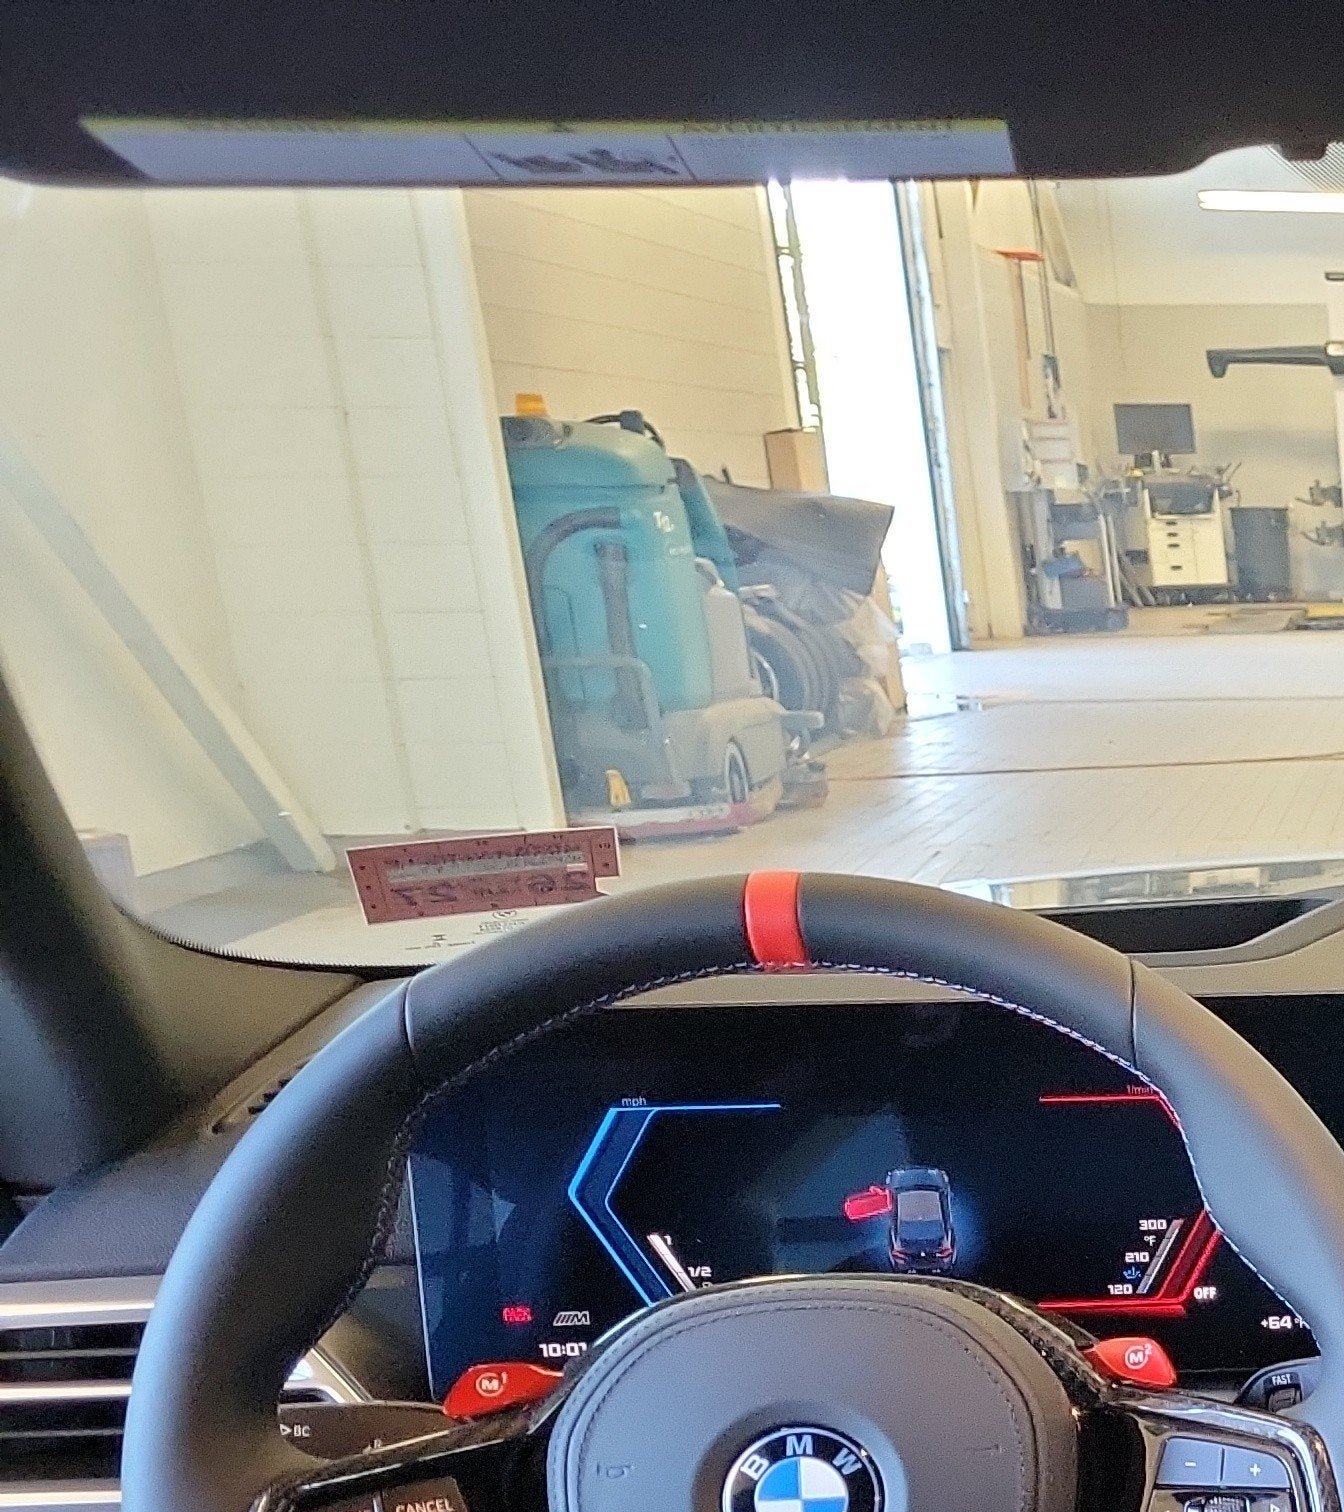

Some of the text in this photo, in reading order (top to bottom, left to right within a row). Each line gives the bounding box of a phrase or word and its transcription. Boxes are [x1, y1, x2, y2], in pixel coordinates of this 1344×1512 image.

[621, 1096, 647, 1107] mph
[1138, 1219, 1167, 1230] 300
[1124, 1252, 1150, 1263] 210
[688, 1266, 713, 1278] 1/2
[1107, 1284, 1133, 1295] 120
[1193, 1286, 1217, 1300] OFF
[538, 1342, 588, 1358] 10:01
[1271, 1374, 1291, 1386] FAST
[739, 1434, 863, 1481] BMW
